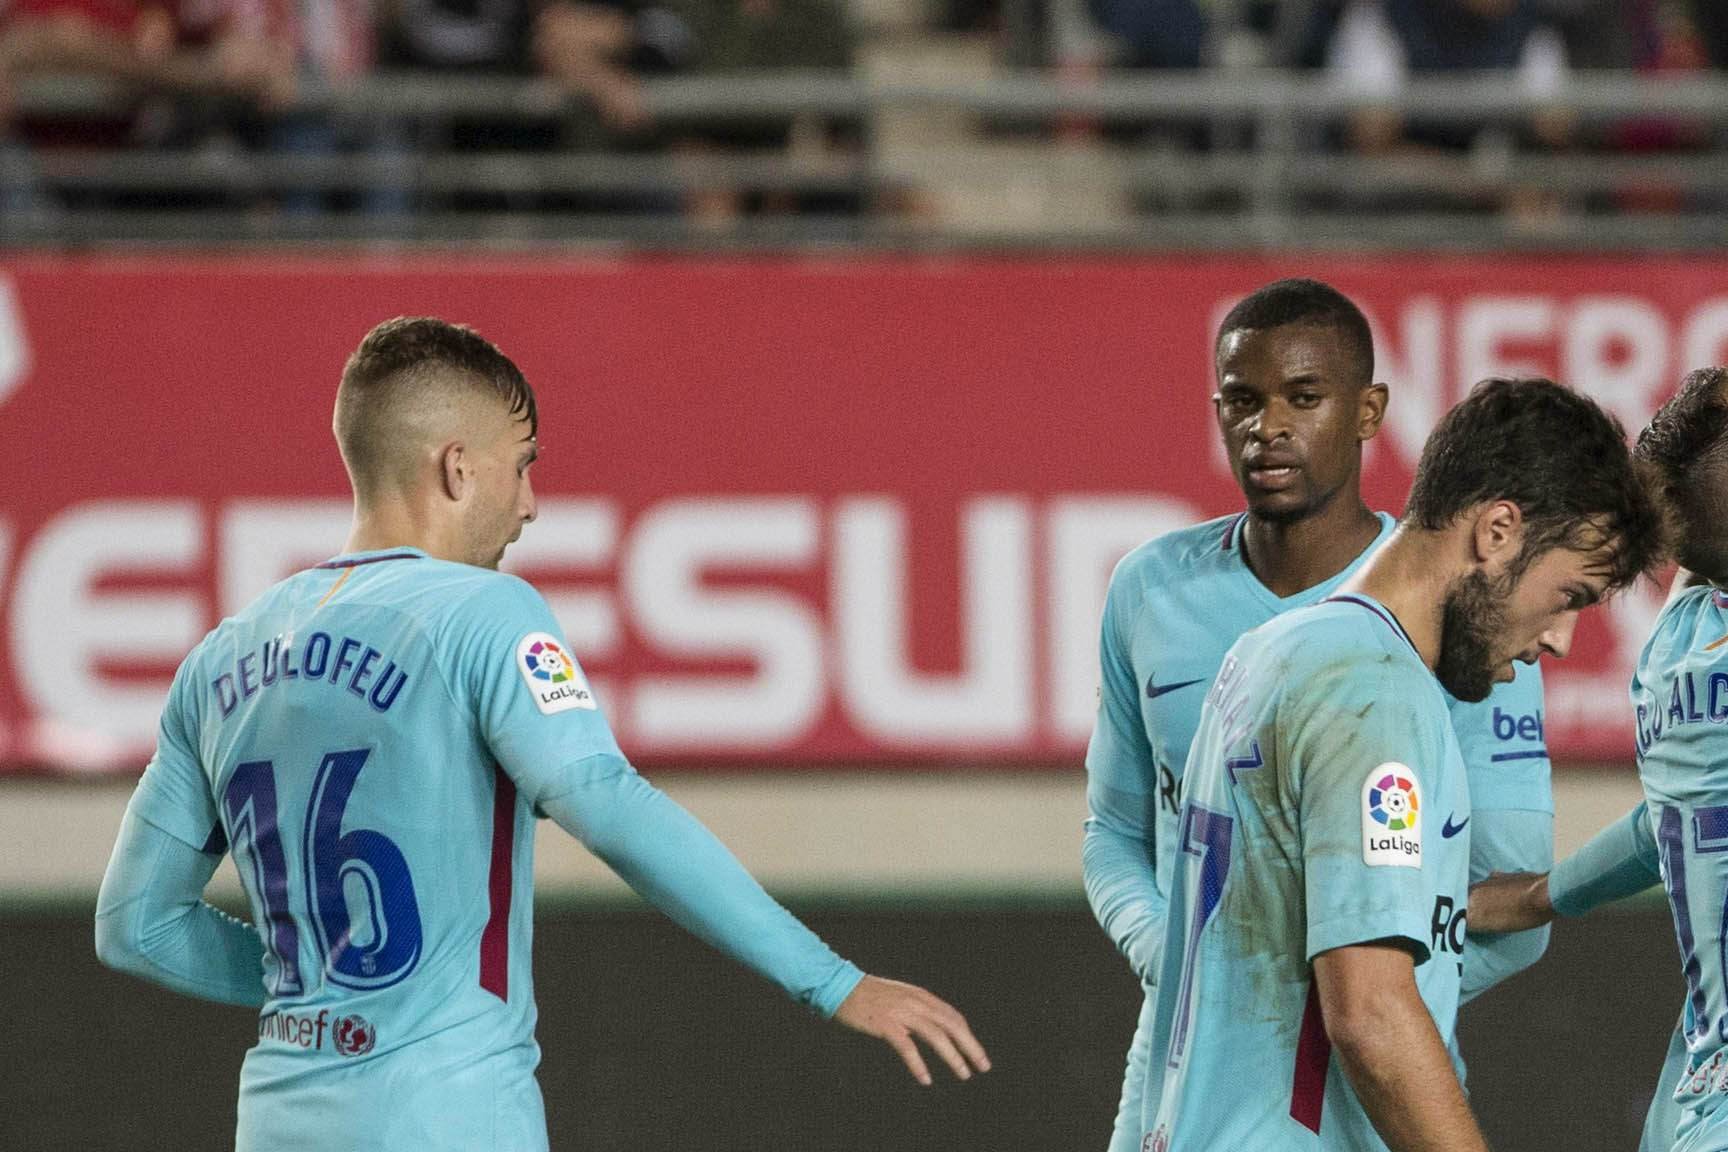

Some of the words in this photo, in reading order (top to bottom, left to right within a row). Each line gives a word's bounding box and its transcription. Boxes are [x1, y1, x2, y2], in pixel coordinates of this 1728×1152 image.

[212, 632, 408, 721] DEULOFEU
[1493, 707, 1543, 741] be
[1635, 702, 1663, 761] CO
[222, 743, 423, 997] 16
[1369, 836, 1420, 856] LaLiga
